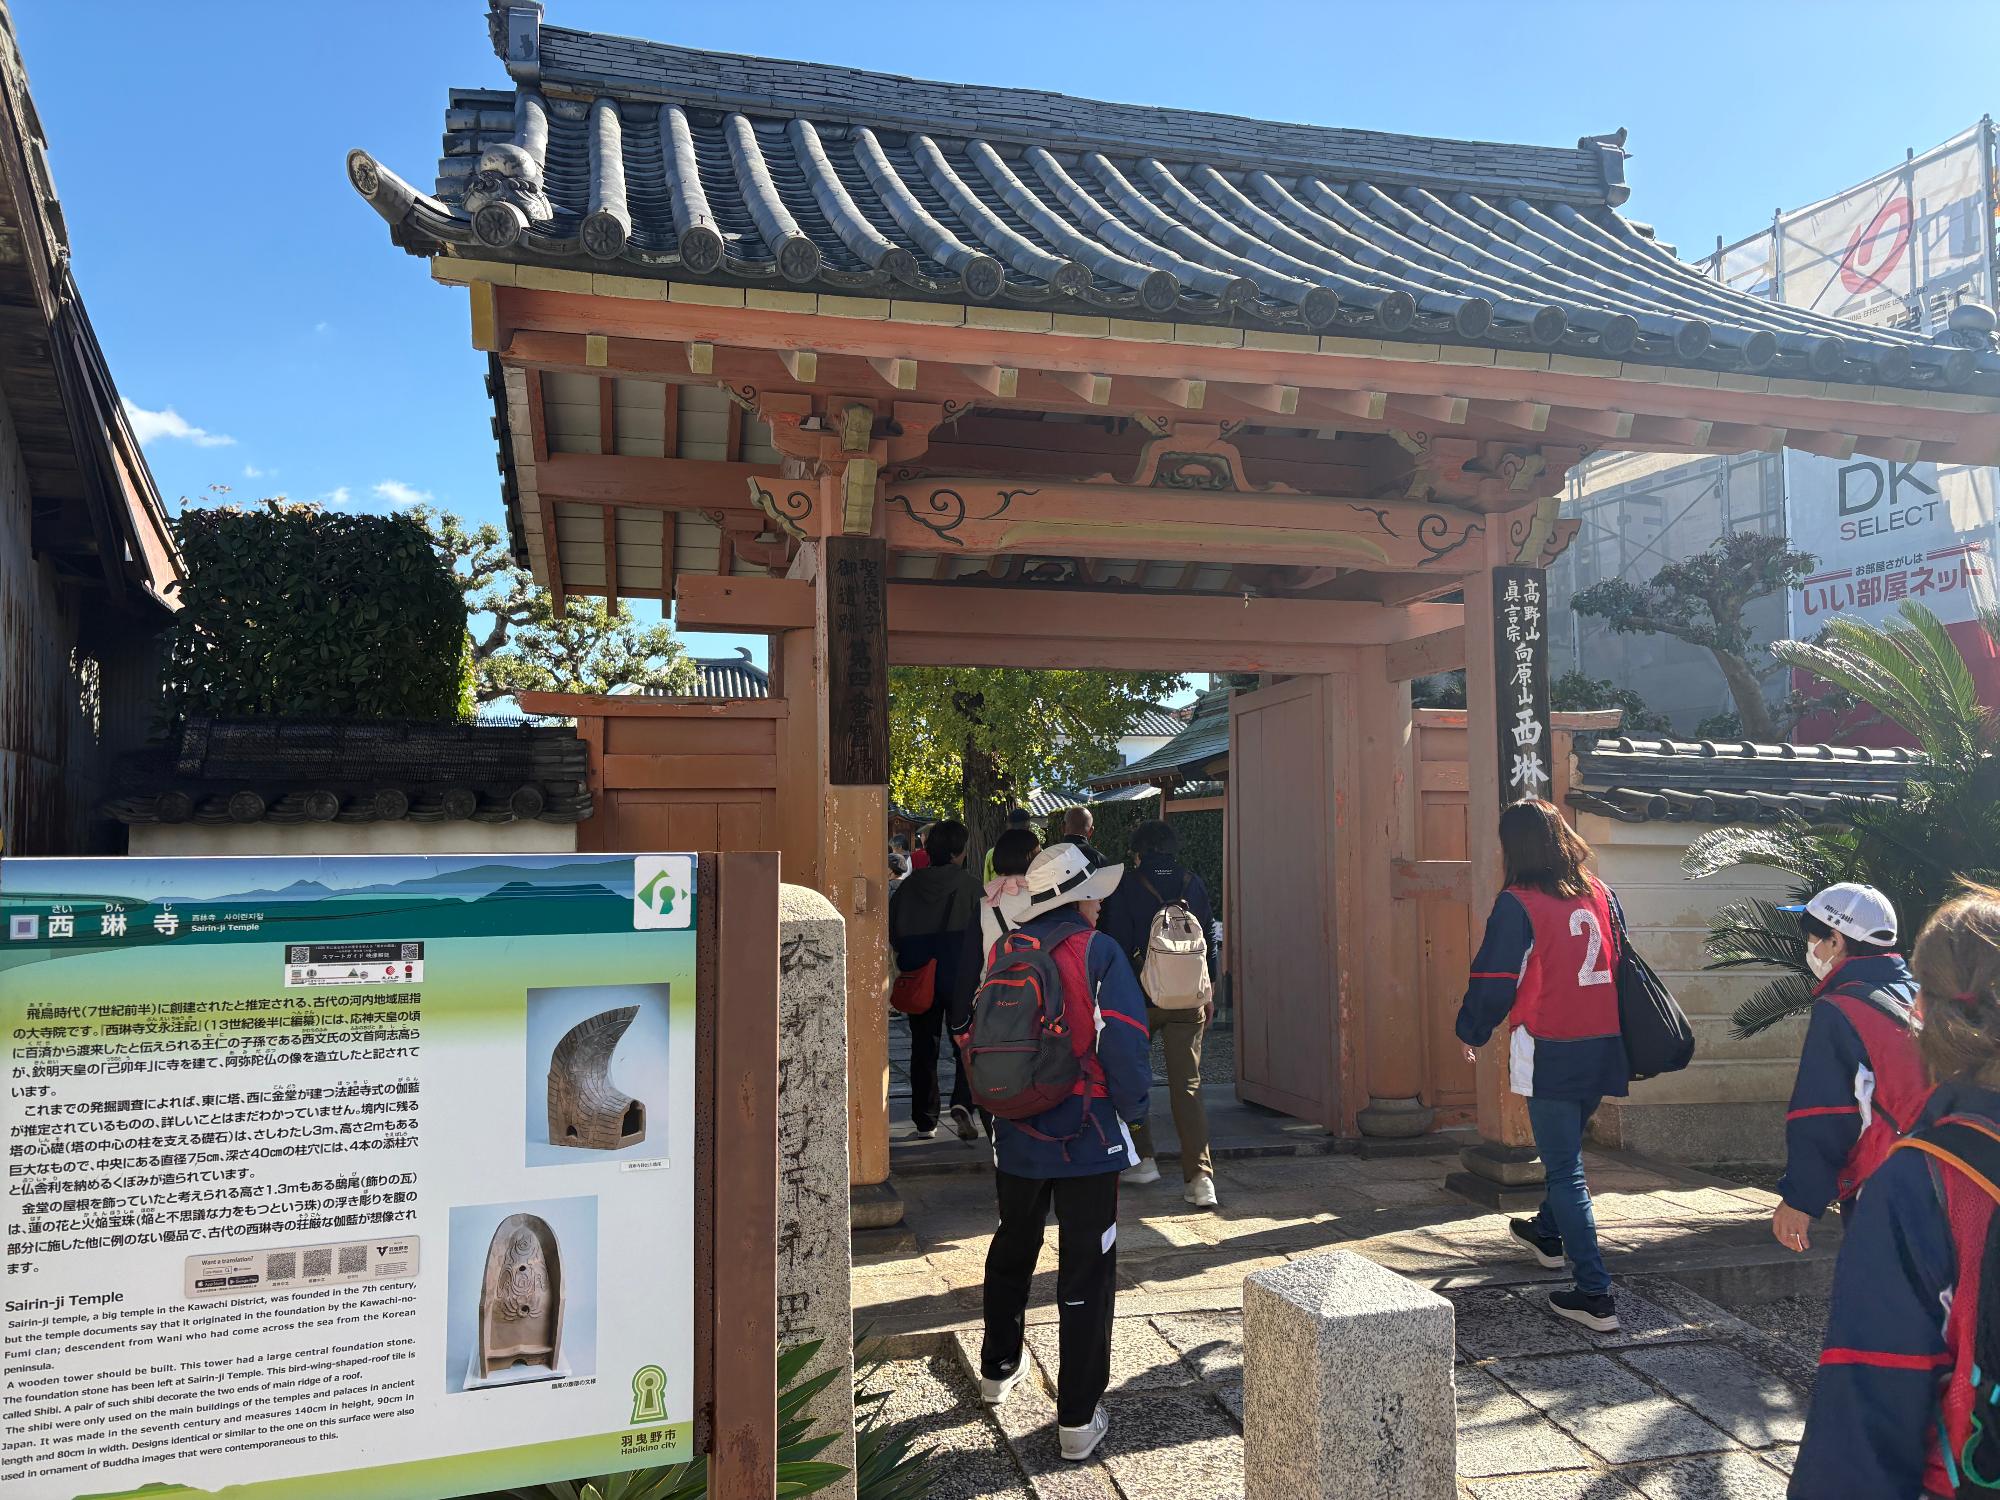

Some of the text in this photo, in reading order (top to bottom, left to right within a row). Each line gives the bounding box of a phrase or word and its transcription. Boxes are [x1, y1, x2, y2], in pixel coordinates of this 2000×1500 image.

[1838, 460, 1940, 517] DK
[1839, 500, 1939, 541] SELECT
[1855, 553, 1924, 577] お部屋さがしは
[1803, 558, 1983, 616] いい部屋ネット
[51, 904, 73, 914] さい
[104, 903, 125, 913] りん
[163, 902, 173, 911] じ
[48, 913, 180, 938] 西琳寺
[1569, 908, 1613, 988] 2
[11, 1085, 57, 1098] います。
[7, 1262, 39, 1275] ます。
[4, 1291, 123, 1312] Sairin-ji Temple
[8, 1317, 48, 1328] Sairin-ji
[52, 1314, 89, 1324] temple,
[102, 1311, 117, 1320] big
[120, 1307, 154, 1317] temple
[156, 1306, 165, 1314] in
[168, 1304, 185, 1313] the
[187, 1299, 227, 1311] Kawachi
[230, 1296, 267, 1306] District,
[291, 1289, 329, 1300] founded
[332, 1288, 341, 1296] in
[343, 1287, 359, 1295] the
[361, 1280, 377, 1293] 7th
[379, 1278, 416, 1291] century,
[4, 1335, 22, 1344] but
[25, 1333, 42, 1341] the
[45, 1329, 80, 1340] temple
[83, 1324, 137, 1336] documents
[140, 1323, 157, 1331] say
[159, 1319, 180, 1328] that
[182, 1318, 190, 1326] it
[192, 1313, 241, 1325] originated
[255, 1310, 271, 1318] the
[274, 1305, 325, 1316] foundation
[328, 1303, 339, 1311] by
[341, 1301, 357, 1309] the
[359, 1296, 416, 1307] Kawachi-no-
[4, 1348, 31, 1359] Fumi
[34, 1347, 60, 1356] clan;
[64, 1340, 125, 1352] descendent
[128, 1338, 153, 1346] from
[156, 1333, 182, 1343] Wani
[185, 1332, 206, 1340] who
[210, 1328, 228, 1338] had
[232, 1327, 259, 1335] come
[262, 1323, 294, 1332] across
[297, 1320, 313, 1328] the
[336, 1316, 359, 1324] from
[363, 1313, 379, 1321] the
[382, 1309, 415, 1319] Korean
[4, 1362, 54, 1376] peninsula.
[17, 1377, 59, 1388] wooden
[63, 1373, 93, 1382] tower
[96, 1368, 131, 1379] should
[134, 1367, 147, 1375] be
[150, 1364, 176, 1373] built.
[179, 1361, 201, 1370] This
[204, 1359, 233, 1367] tower
[236, 1354, 254, 1364] had
[266, 1352, 291, 1360] large
[294, 1346, 328, 1357] central
[331, 1341, 383, 1353] foundation
[386, 1338, 415, 1346] stone.
[2, 1409, 31, 1420] called
[34, 1405, 61, 1416] Shibi.
[74, 1402, 93, 1413] pair
[95, 1400, 105, 1409] of
[107, 1398, 129, 1407] such
[132, 1395, 154, 1405] shibi
[156, 1391, 197, 1402] decorate
[199, 1389, 215, 1397] the
[217, 1387, 234, 1395] two
[236, 1383, 259, 1393] ends
[261, 1381, 271, 1390] of
[272, 1379, 295, 1388] main
[297, 1377, 321, 1386] ridge
[322, 1374, 332, 1382] of
[342, 1371, 362, 1380] roof.
[1, 1440, 36, 1450] Japan.
[40, 1437, 49, 1445] It
[52, 1435, 73, 1444] was
[76, 1431, 105, 1441] made
[108, 1429, 117, 1437] in
[120, 1427, 137, 1435] the
[140, 1422, 180, 1433] seventh
[182, 1418, 220, 1428] century
[223, 1414, 241, 1423] and
[244, 1409, 291, 1421] measures
[295, 1405, 326, 1414] 140cm
[341, 1398, 374, 1409] height,
[377, 1395, 402, 1404] 90cm
[405, 1393, 414, 1401] in
[621, 1429, 677, 1447] 羽曳野市
[0, 1470, 25, 1481] used
[27, 1469, 37, 1477] in
[39, 1463, 88, 1476] ornament
[90, 1460, 100, 1469] of
[102, 1457, 139, 1467] Buddha
[141, 1452, 175, 1462] images
[178, 1449, 197, 1458] that
[199, 1447, 222, 1455] were
[224, 1436, 305, 1452] contemporaneous
[319, 1431, 338, 1440] this.
[621, 1441, 677, 1455] Habikino city
